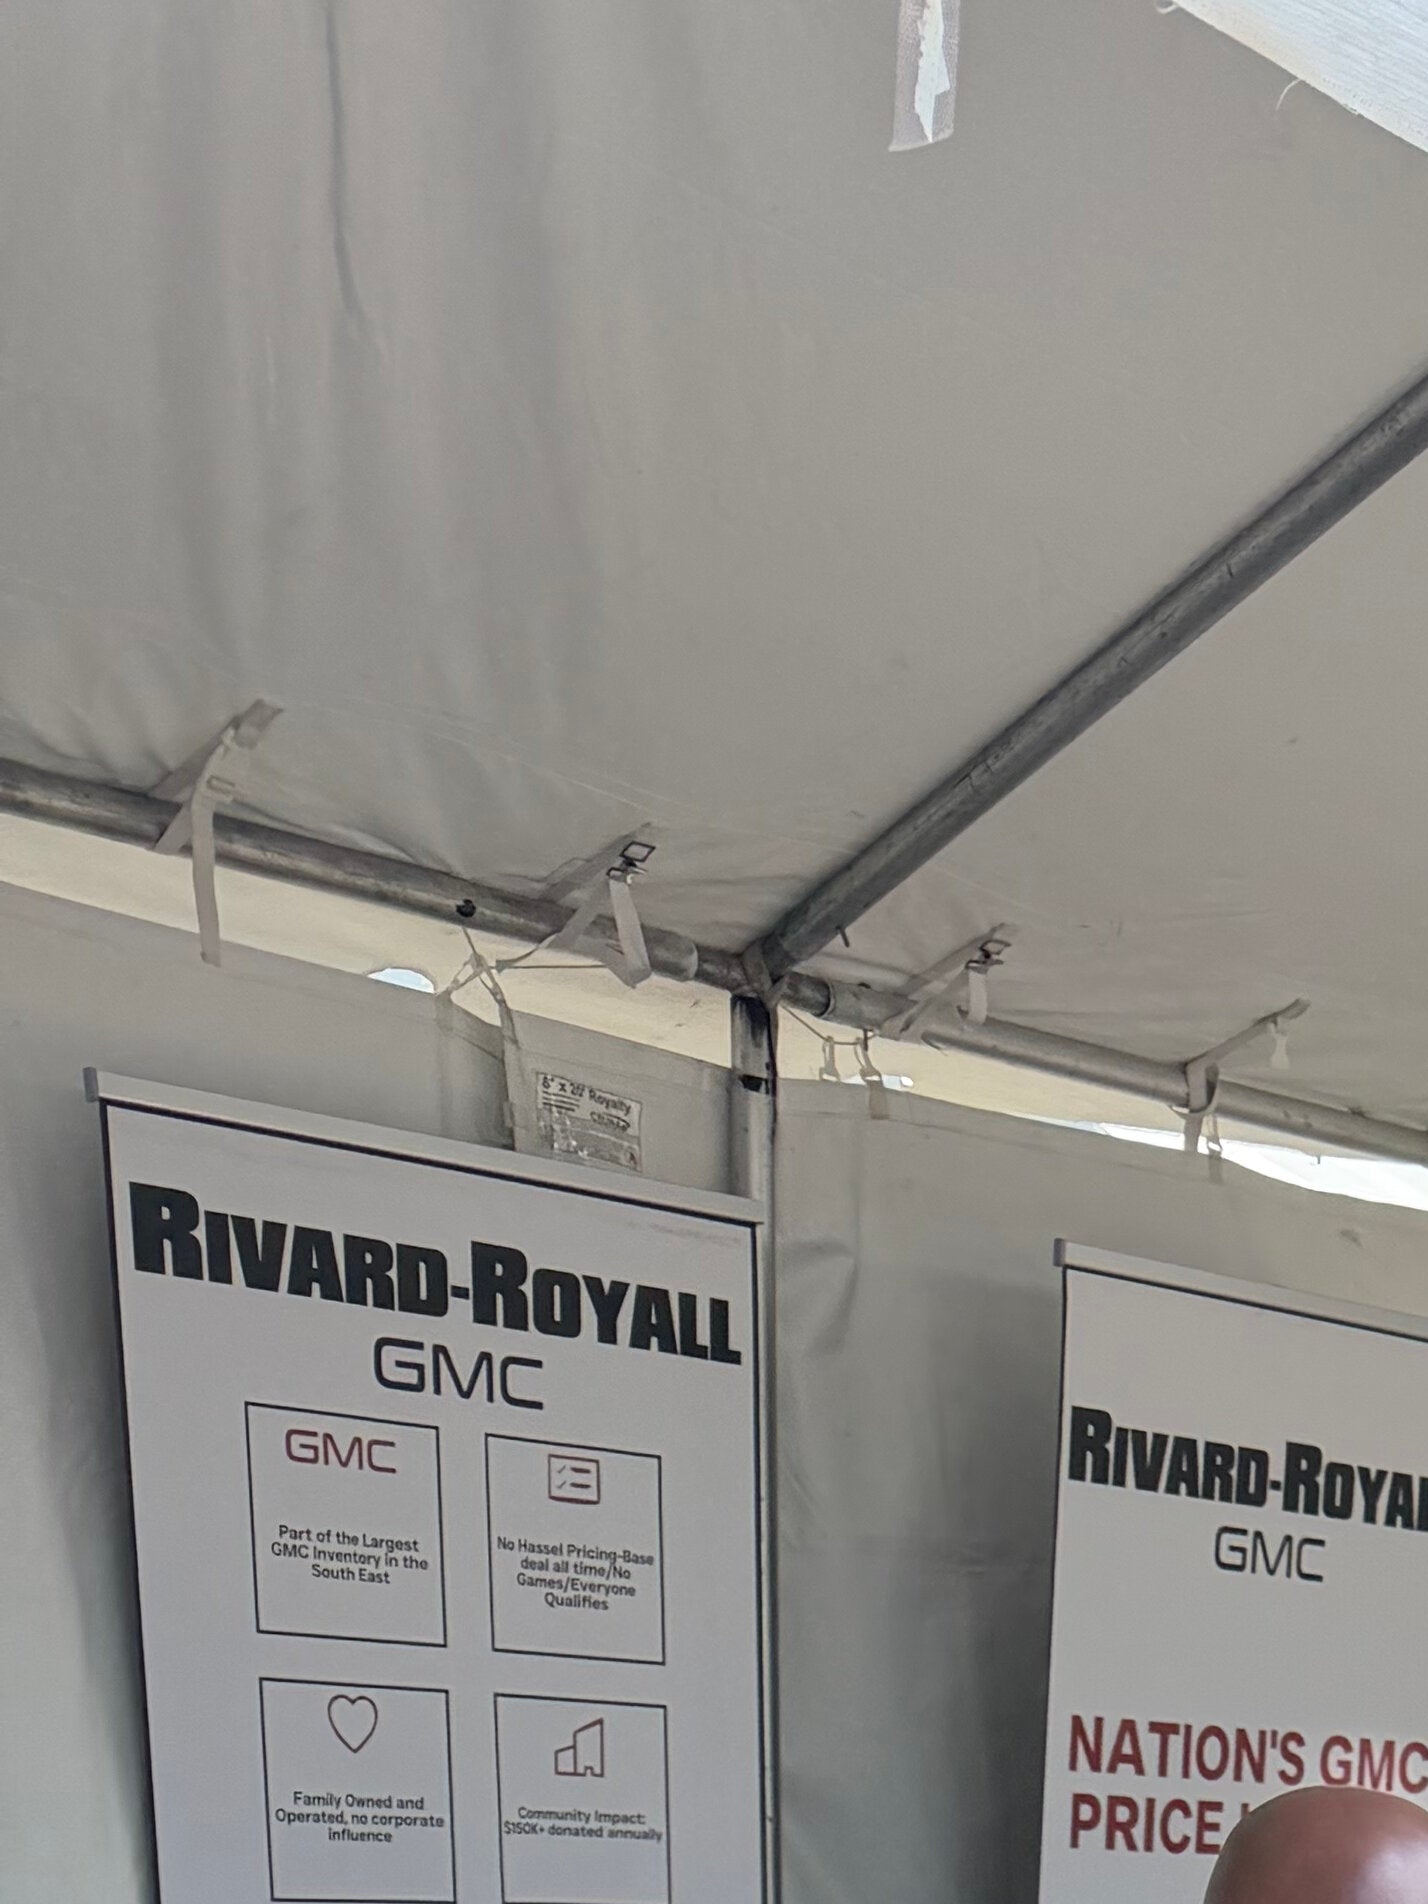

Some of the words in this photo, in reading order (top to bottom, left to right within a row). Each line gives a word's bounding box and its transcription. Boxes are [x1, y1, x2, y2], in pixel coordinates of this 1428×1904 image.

[129, 1181, 742, 1365] RIVARD-ROYALL
[373, 1336, 543, 1411] GMC
[285, 1429, 396, 1473] GMC
[279, 1525, 312, 1541] Part
[316, 1530, 332, 1543] of
[336, 1532, 359, 1546] the
[363, 1534, 419, 1552] Largest
[497, 1536, 515, 1551] No
[518, 1538, 563, 1556] Hassel
[271, 1541, 309, 1559] GMC
[313, 1546, 381, 1569] Inventory
[385, 1552, 399, 1568] in
[403, 1555, 428, 1570] the
[1214, 1525, 1326, 1582] GMC
[311, 1564, 355, 1581] South
[358, 1568, 390, 1584] East
[520, 1556, 548, 1572] deal
[552, 1560, 569, 1574] all
[516, 1572, 636, 1597] Games/Everyone
[544, 1592, 609, 1611] Qualifies
[1069, 1714, 1305, 1786] NATION'S
[293, 1791, 342, 1809] Family
[345, 1794, 392, 1809] Owned
[396, 1797, 425, 1810] and
[274, 1808, 348, 1825] Operated,
[351, 1814, 368, 1825] no
[371, 1813, 444, 1828] corporate
[517, 1806, 591, 1824] Community
[1070, 1793, 1223, 1855] PRICE
[328, 1827, 393, 1843] influence
[548, 1824, 603, 1838] donated
[607, 1827, 663, 1843] annually
